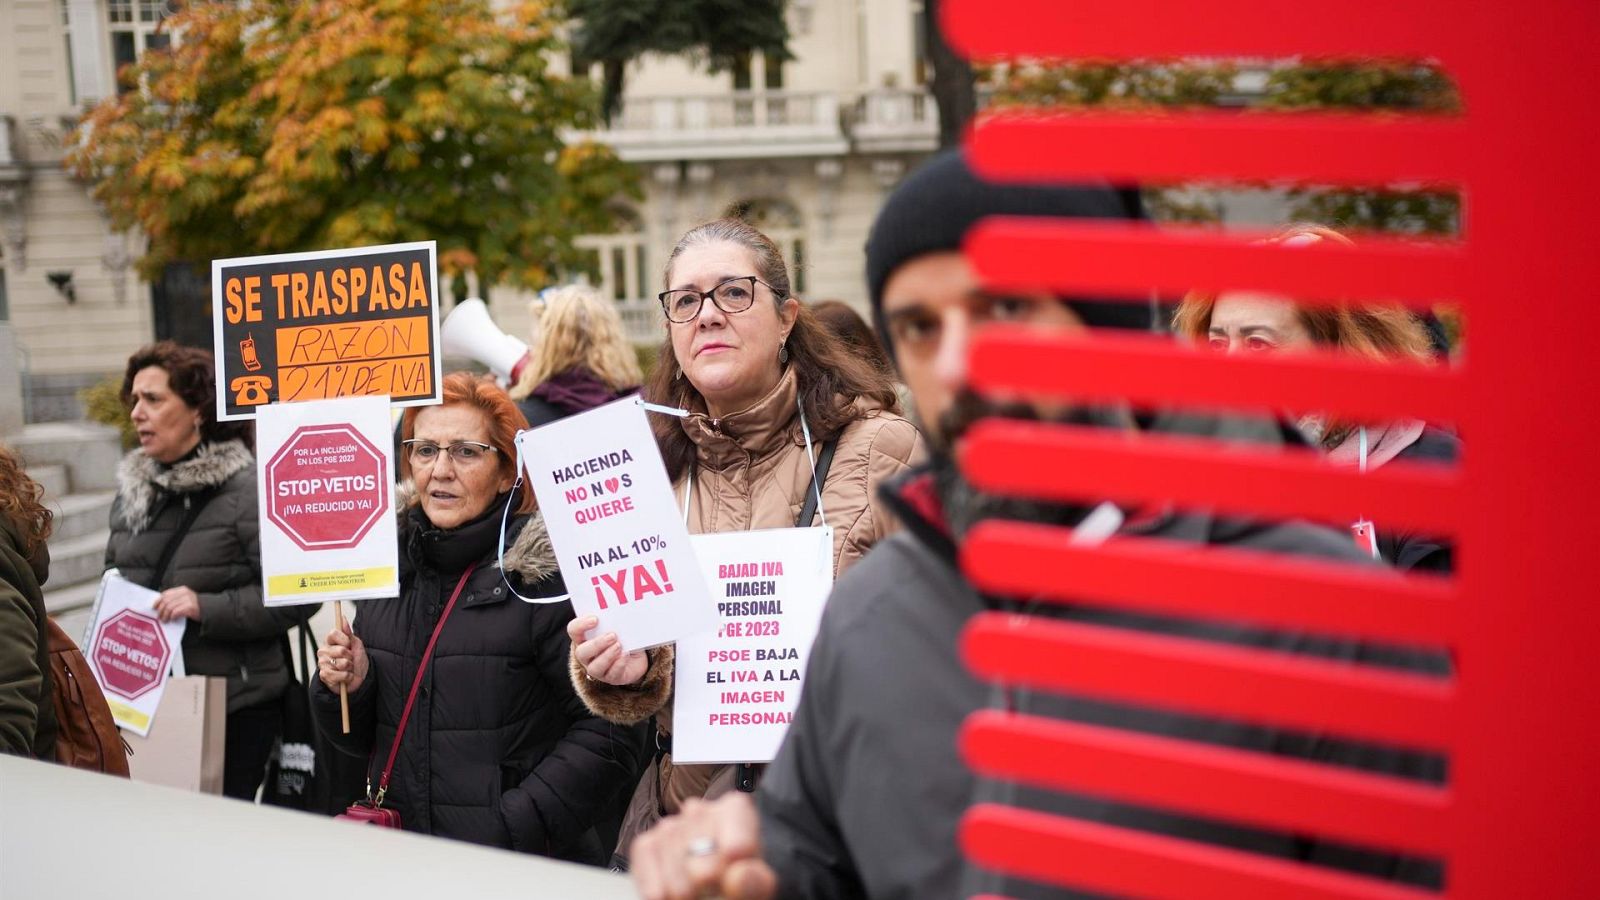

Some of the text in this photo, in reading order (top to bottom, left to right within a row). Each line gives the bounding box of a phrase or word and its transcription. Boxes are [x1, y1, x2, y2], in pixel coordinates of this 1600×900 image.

[226, 261, 428, 324] SE TRASPASA
[289, 321, 413, 363] RAZÓN
[351, 361, 388, 396] DE
[293, 444, 358, 456] POR LA INCLUSIÓN
[297, 454, 355, 466] EN LOS PGE 2023
[552, 449, 634, 485] HACIENDA
[278, 474, 376, 497] STOP VETOS
[565, 486, 588, 504] NO
[283, 499, 372, 517] ¡IVA REDUCIDO YA!
[574, 496, 634, 525] QUIERE
[577, 534, 667, 570] IVA AL 10%
[718, 561, 783, 579] BAJAD IVA
[590, 559, 674, 610] ¡YA!
[726, 581, 776, 597] IMAGEN
[717, 600, 783, 617] PERSONAL
[745, 621, 780, 637] 2023
[101, 636, 161, 670] STOP VETOS
[708, 648, 799, 662] PSOE BAJA
[706, 669, 800, 684] EL IVA A LA
[721, 690, 785, 704] IMAGEN
